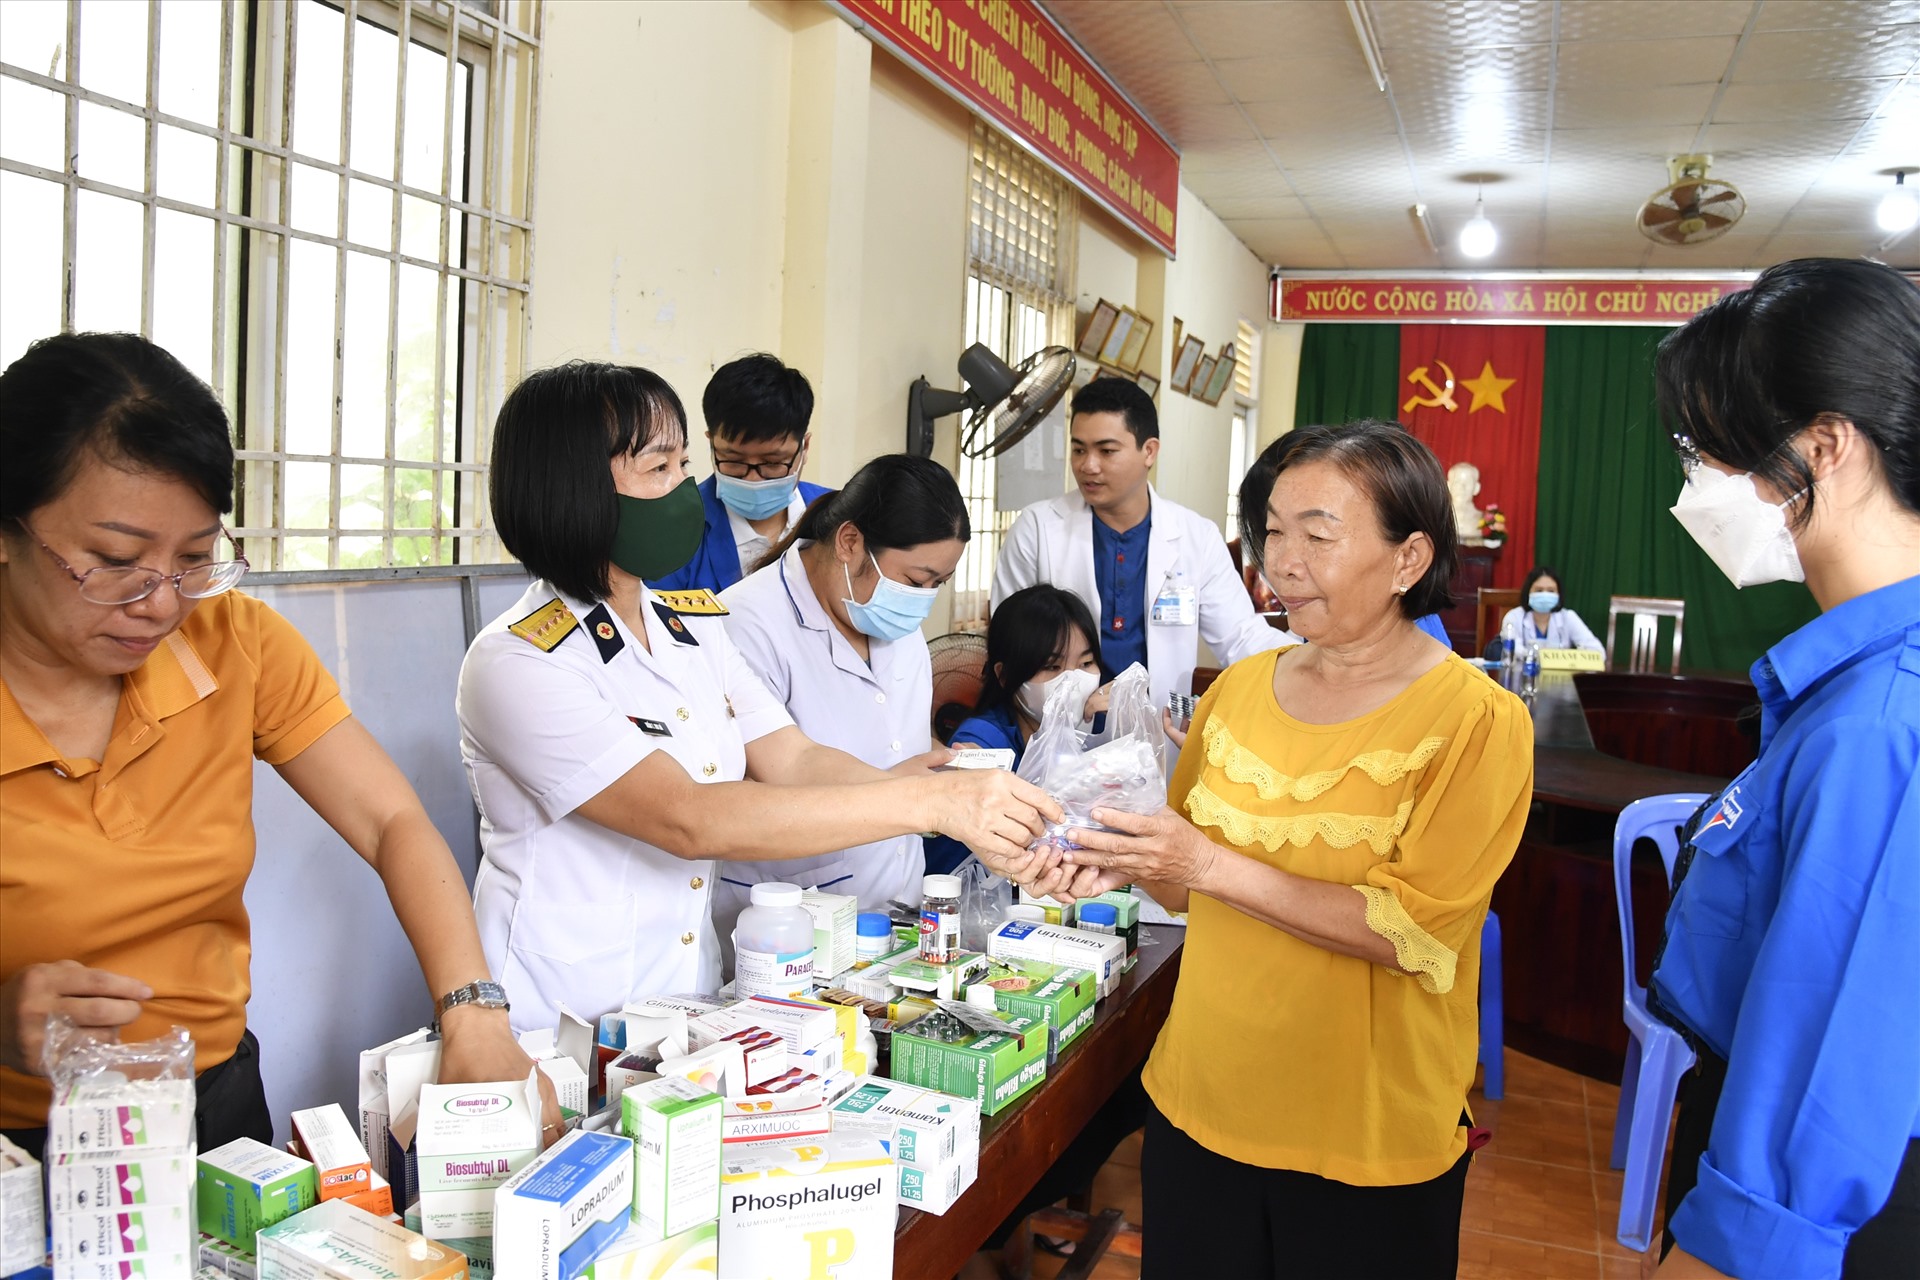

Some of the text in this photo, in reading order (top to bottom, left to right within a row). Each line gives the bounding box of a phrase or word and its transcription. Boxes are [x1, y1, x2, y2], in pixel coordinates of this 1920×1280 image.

[1051, 50, 1072, 98] LAO
[900, 0, 943, 52] THEO
[946, 18, 969, 71] TƯ
[1021, 82, 1046, 136] ĐẠO
[1074, 129, 1107, 184] PHONG
[1305, 286, 1367, 311] NƯỚC
[1373, 285, 1438, 316] CỘNG
[1444, 285, 1495, 312] HÒA
[1503, 286, 1536, 312] XÃ
[1542, 286, 1588, 317] HỘI
[1594, 282, 1648, 313] CHỦ
[1037, 929, 1106, 949] Klamentin
[624, 1074, 635, 1086] 75
[977, 1058, 987, 1084] Ginkgo
[995, 1058, 1046, 1101] Ginkgo Biloba
[456, 1097, 499, 1108] Biosubtyl DL
[847, 1100, 868, 1109] 250
[854, 1091, 879, 1104] 31.25
[362, 1110, 368, 1122] mg
[876, 1103, 946, 1126] Klamentin
[654, 1142, 662, 1156] M
[900, 1151, 914, 1160] 1.25
[445, 1158, 511, 1177] Biosubtyl DL
[905, 1173, 920, 1186] 250
[571, 1169, 626, 1228] LOPRADIUM
[731, 1178, 882, 1214] Phosphalugel
[902, 1187, 922, 1200] 31.25
[736, 1215, 786, 1229] ALUMINIUM
[788, 1209, 837, 1222] PHOSPHATE
